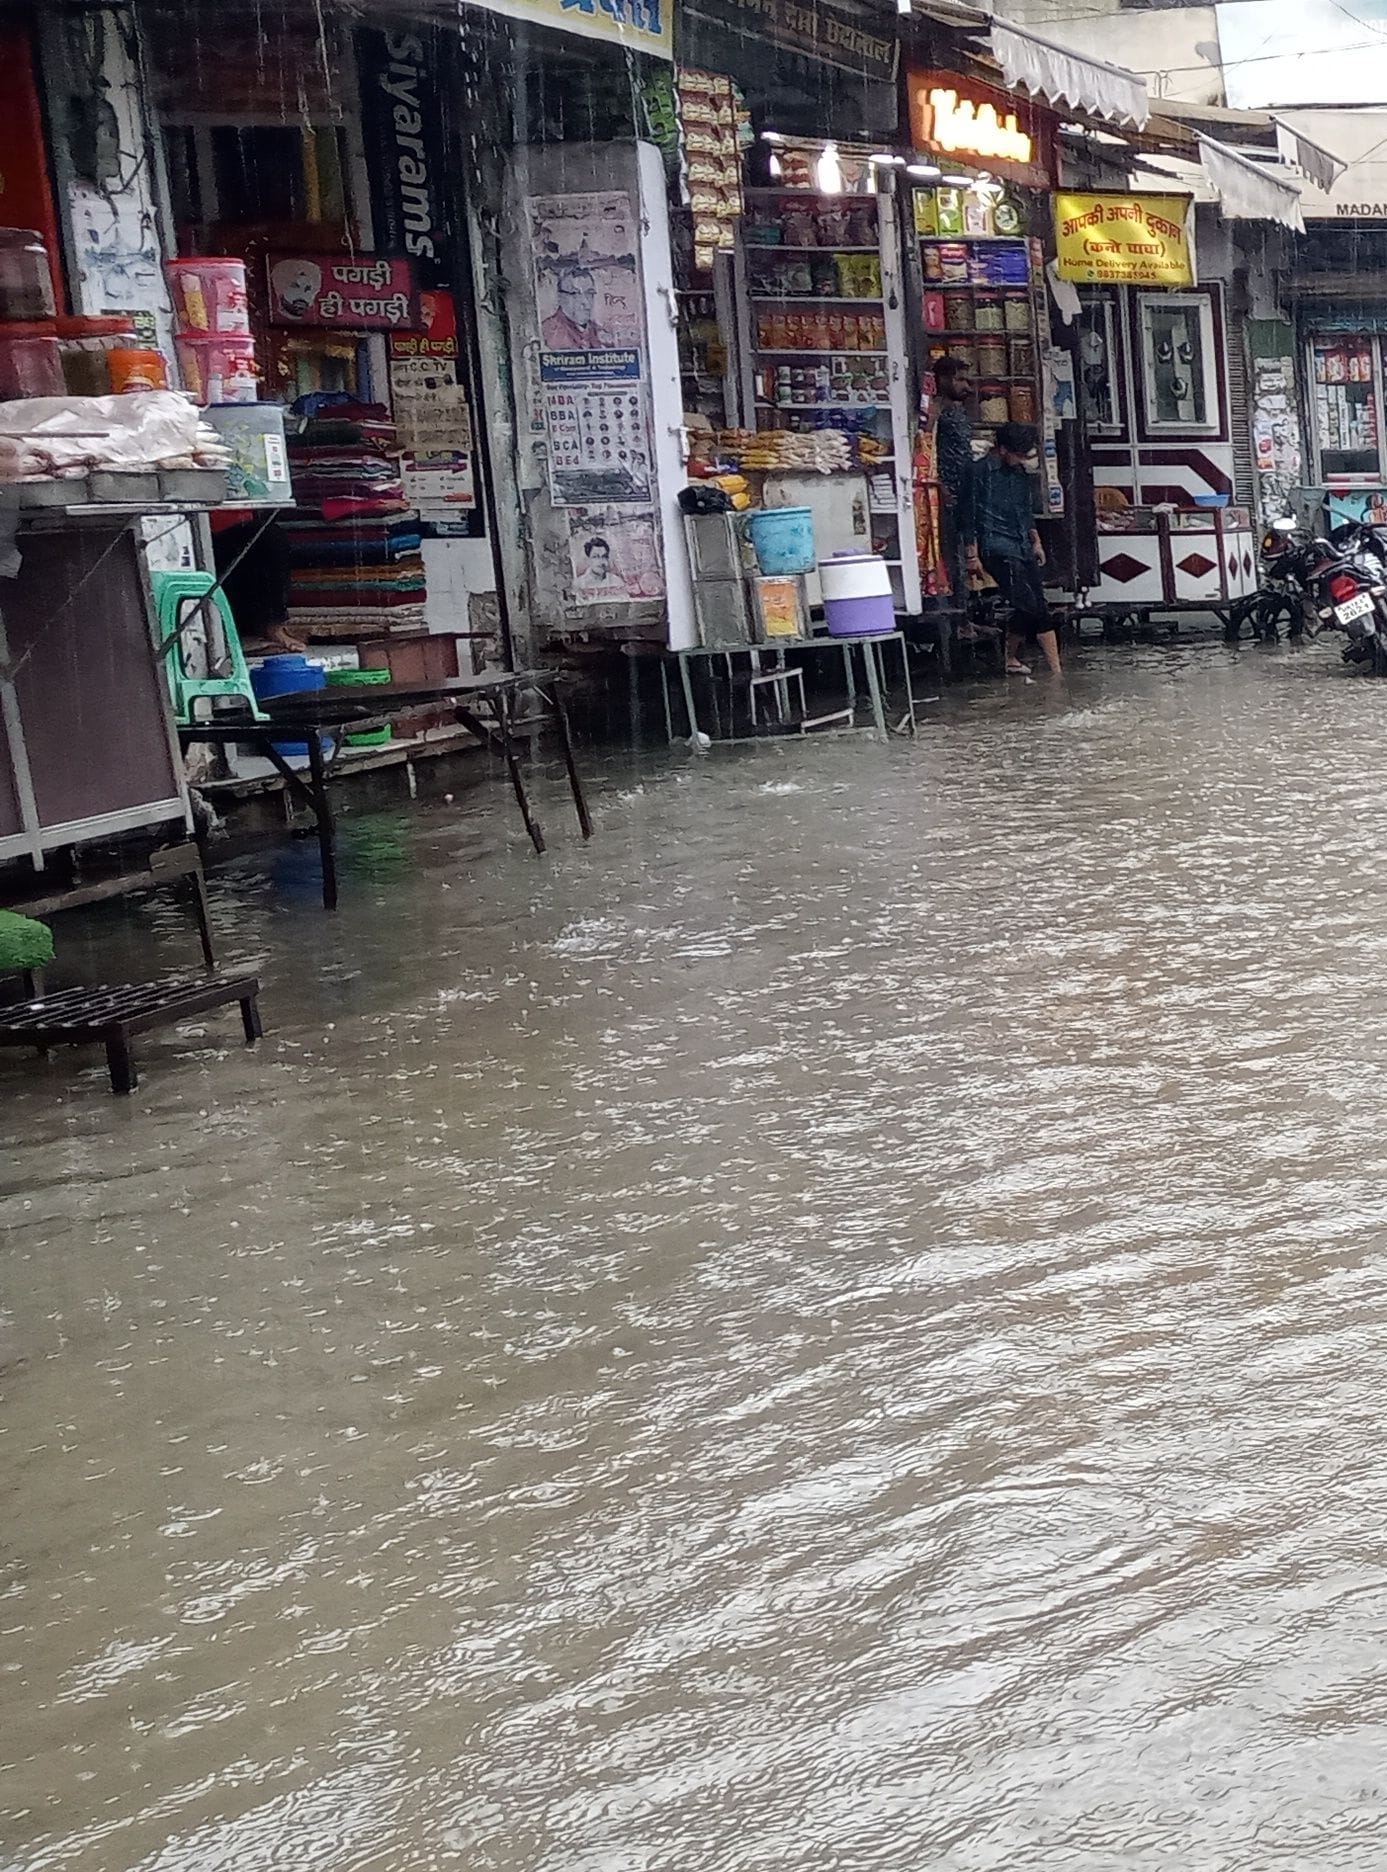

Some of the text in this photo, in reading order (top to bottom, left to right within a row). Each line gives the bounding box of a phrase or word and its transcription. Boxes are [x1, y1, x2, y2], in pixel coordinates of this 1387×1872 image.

[1062, 202, 1182, 244] आपकी अपनी दुकान
[1063, 257, 1185, 270] Home Delivery Available
[331, 261, 392, 291] पगड़ी
[319, 291, 409, 323] ही पगड़ी
[543, 351, 636, 367] Shriram Institute
[550, 410, 576, 421] BBA
